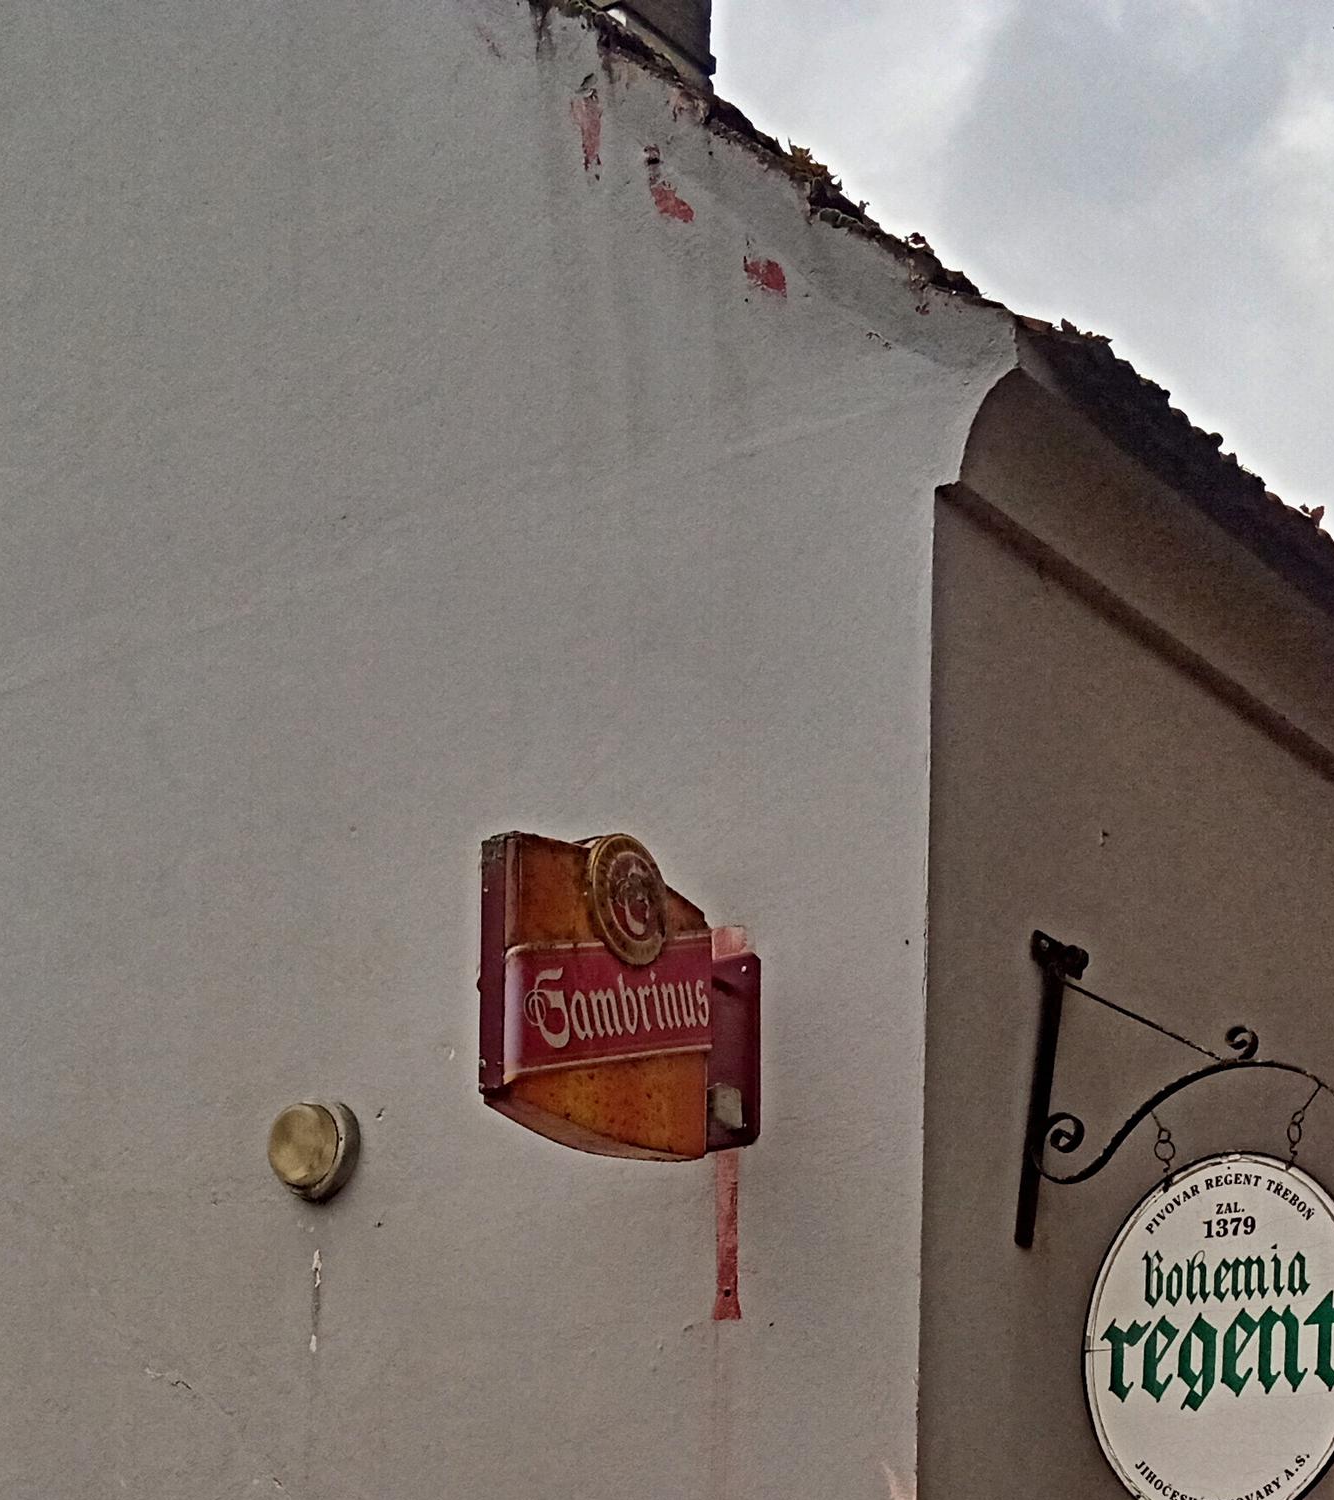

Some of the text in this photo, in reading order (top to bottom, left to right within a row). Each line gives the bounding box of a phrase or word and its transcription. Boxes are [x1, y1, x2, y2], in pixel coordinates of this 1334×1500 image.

[524, 966, 710, 1048] Gambrinus
[1145, 1173, 1315, 1234] PIVOVAR REGENT TŘEBOŇ
[1216, 1202, 1245, 1215] ZAL.
[1203, 1216, 1257, 1238] 1379
[1283, 1453, 1310, 1480] A.S.
